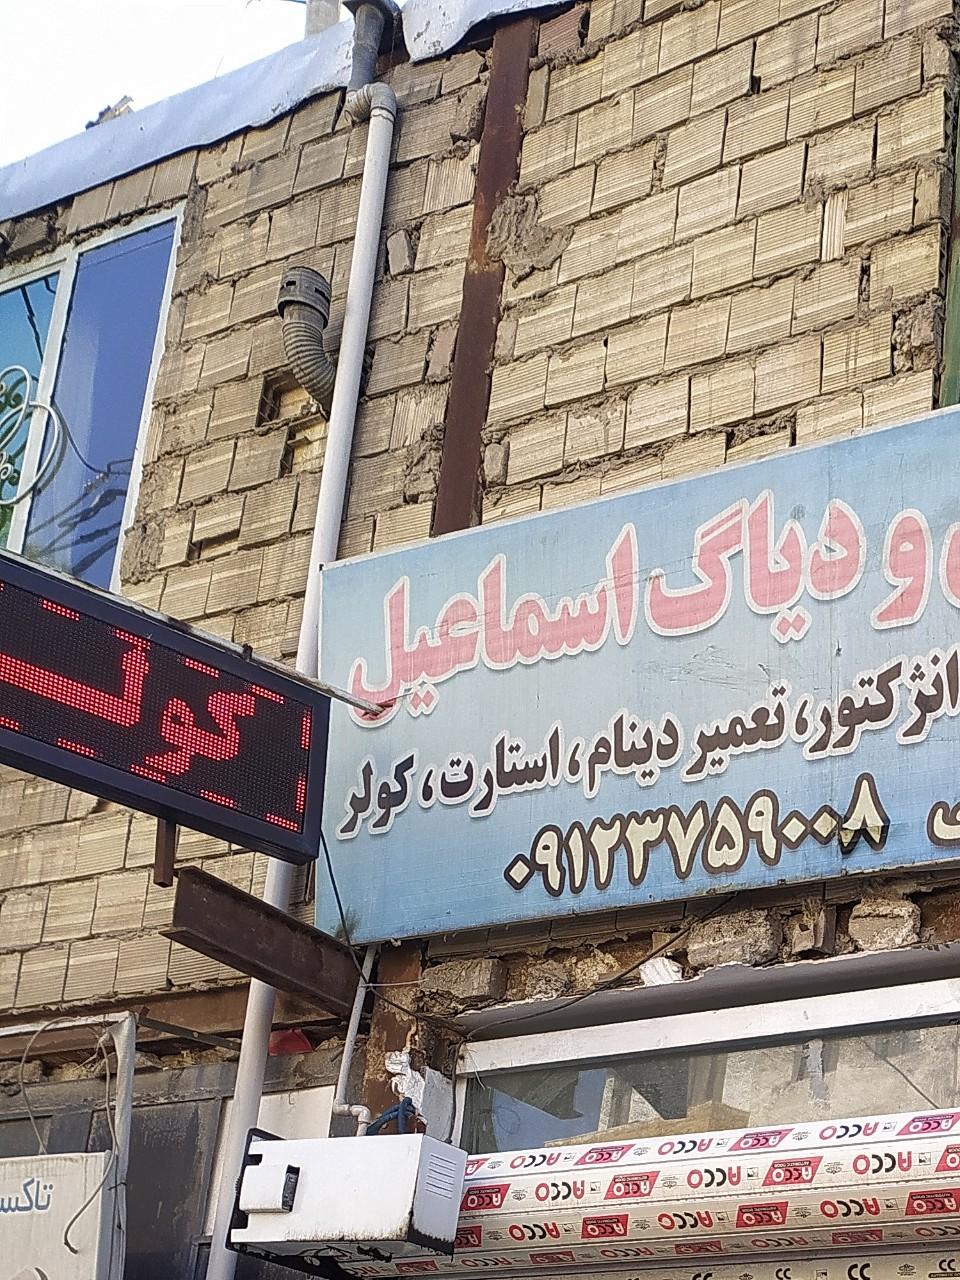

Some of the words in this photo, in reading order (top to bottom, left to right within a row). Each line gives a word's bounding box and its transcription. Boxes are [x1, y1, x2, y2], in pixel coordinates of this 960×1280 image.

[644, 489, 864, 642] دیاگ
[872, 509, 930, 628] و
[349, 523, 639, 725] اسماعیل
[686, 686, 786, 776] تعمیر
[338, 755, 414, 838] کولر
[0, 1177, 54, 1213] تاکس
[687, 1166, 741, 1189] ACCO
[853, 1151, 912, 1175] ACCO
[820, 1197, 881, 1218] ACCO
